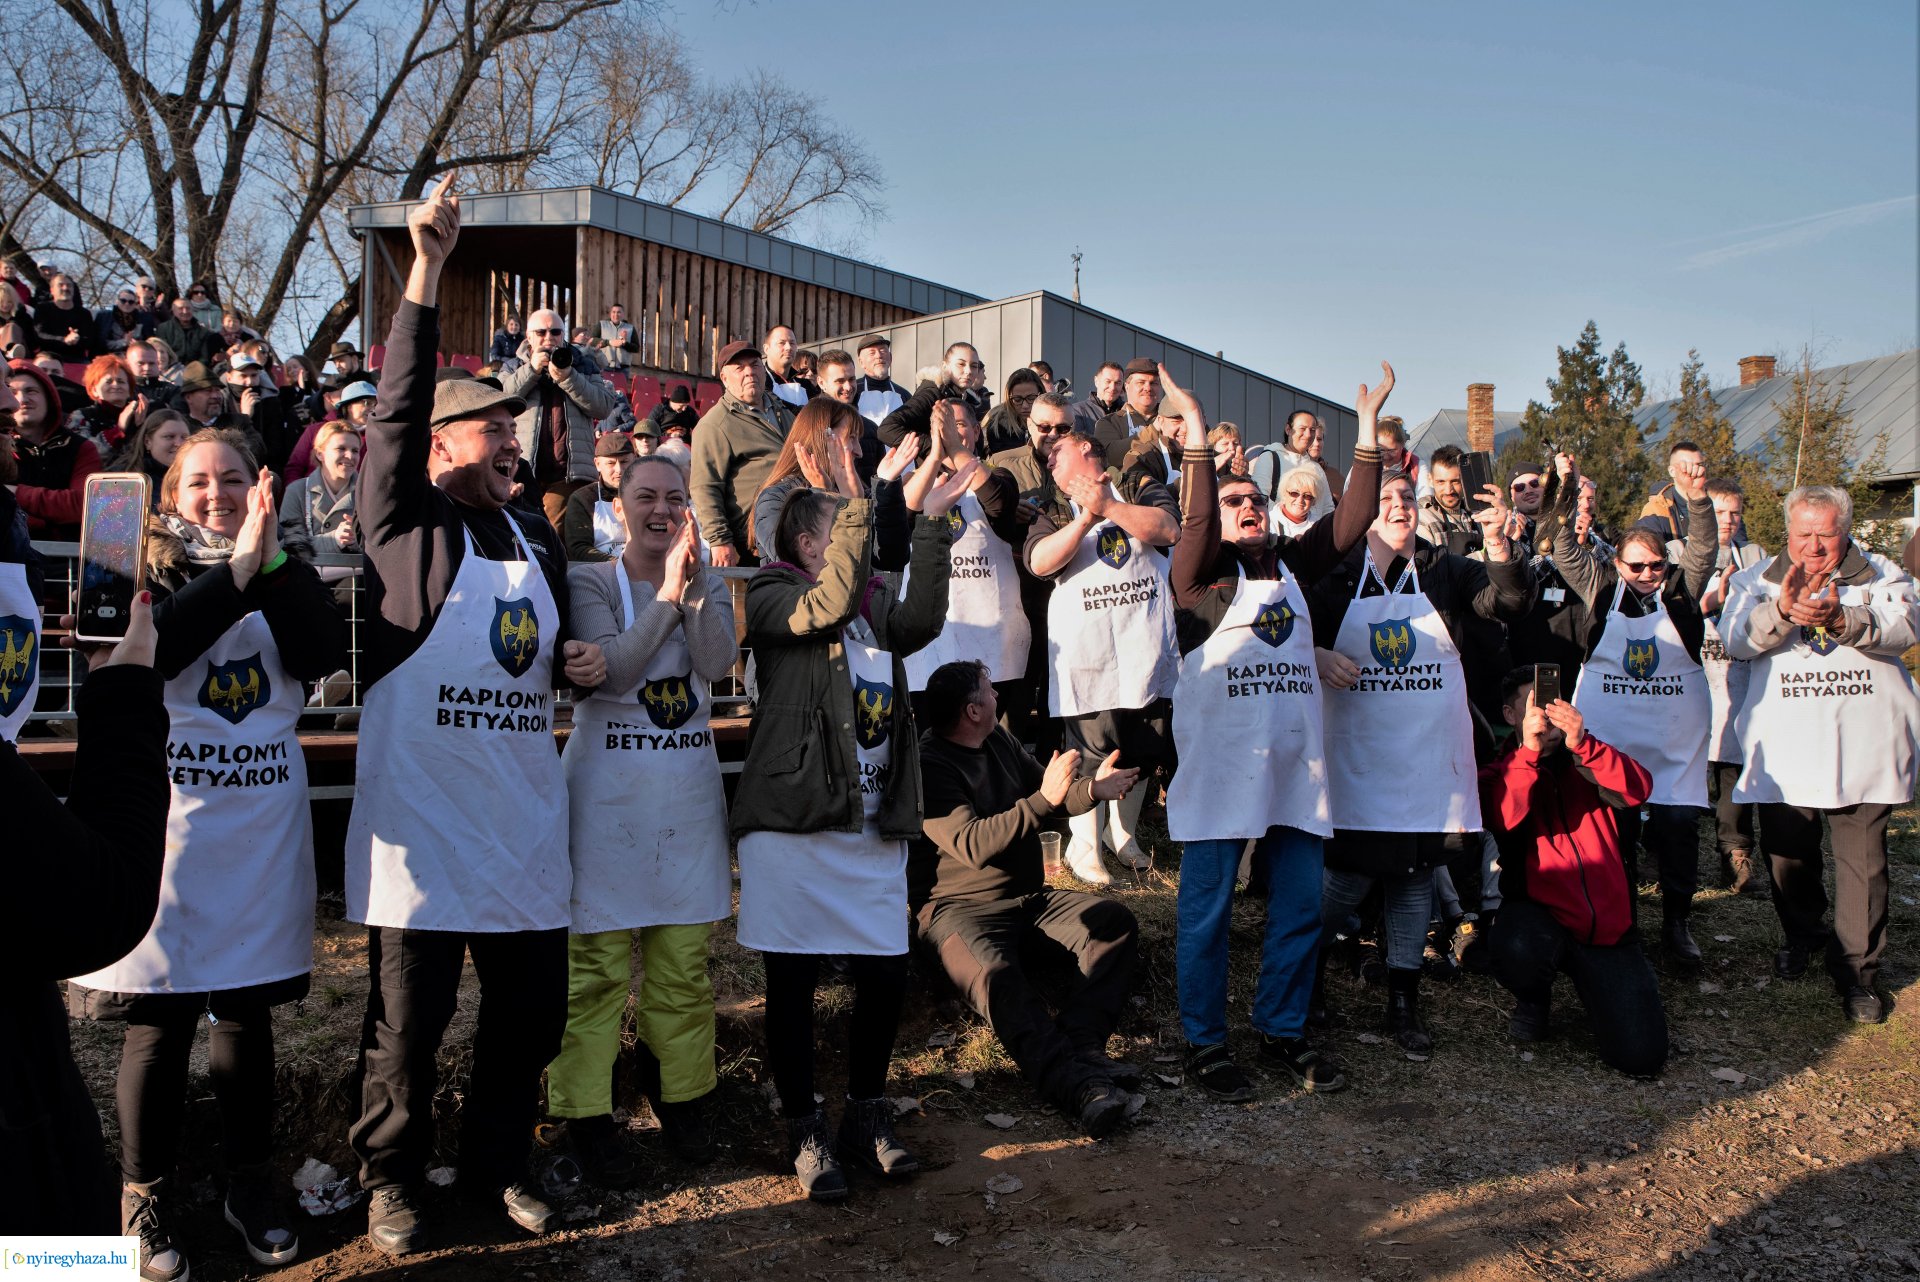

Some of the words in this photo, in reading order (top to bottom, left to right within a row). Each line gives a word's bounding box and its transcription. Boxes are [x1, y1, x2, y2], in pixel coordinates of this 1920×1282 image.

[1082, 576, 1156, 598] KAPLONYI
[1083, 588, 1159, 611] BETYÁROK
[1226, 662, 1312, 681] KAPLONYI
[1360, 663, 1441, 676] APLONYI
[1780, 669, 1871, 684] KAPLONYI
[438, 684, 548, 710] KAPLONYI
[1227, 676, 1314, 698] BETYÁROK
[1603, 682, 1684, 696] BETYÁROK
[1782, 683, 1874, 698] BETYÁROK
[436, 708, 548, 733] BETYÁROK
[605, 730, 712, 751] BETYÁROK
[167, 764, 290, 788] ETYÁROK
